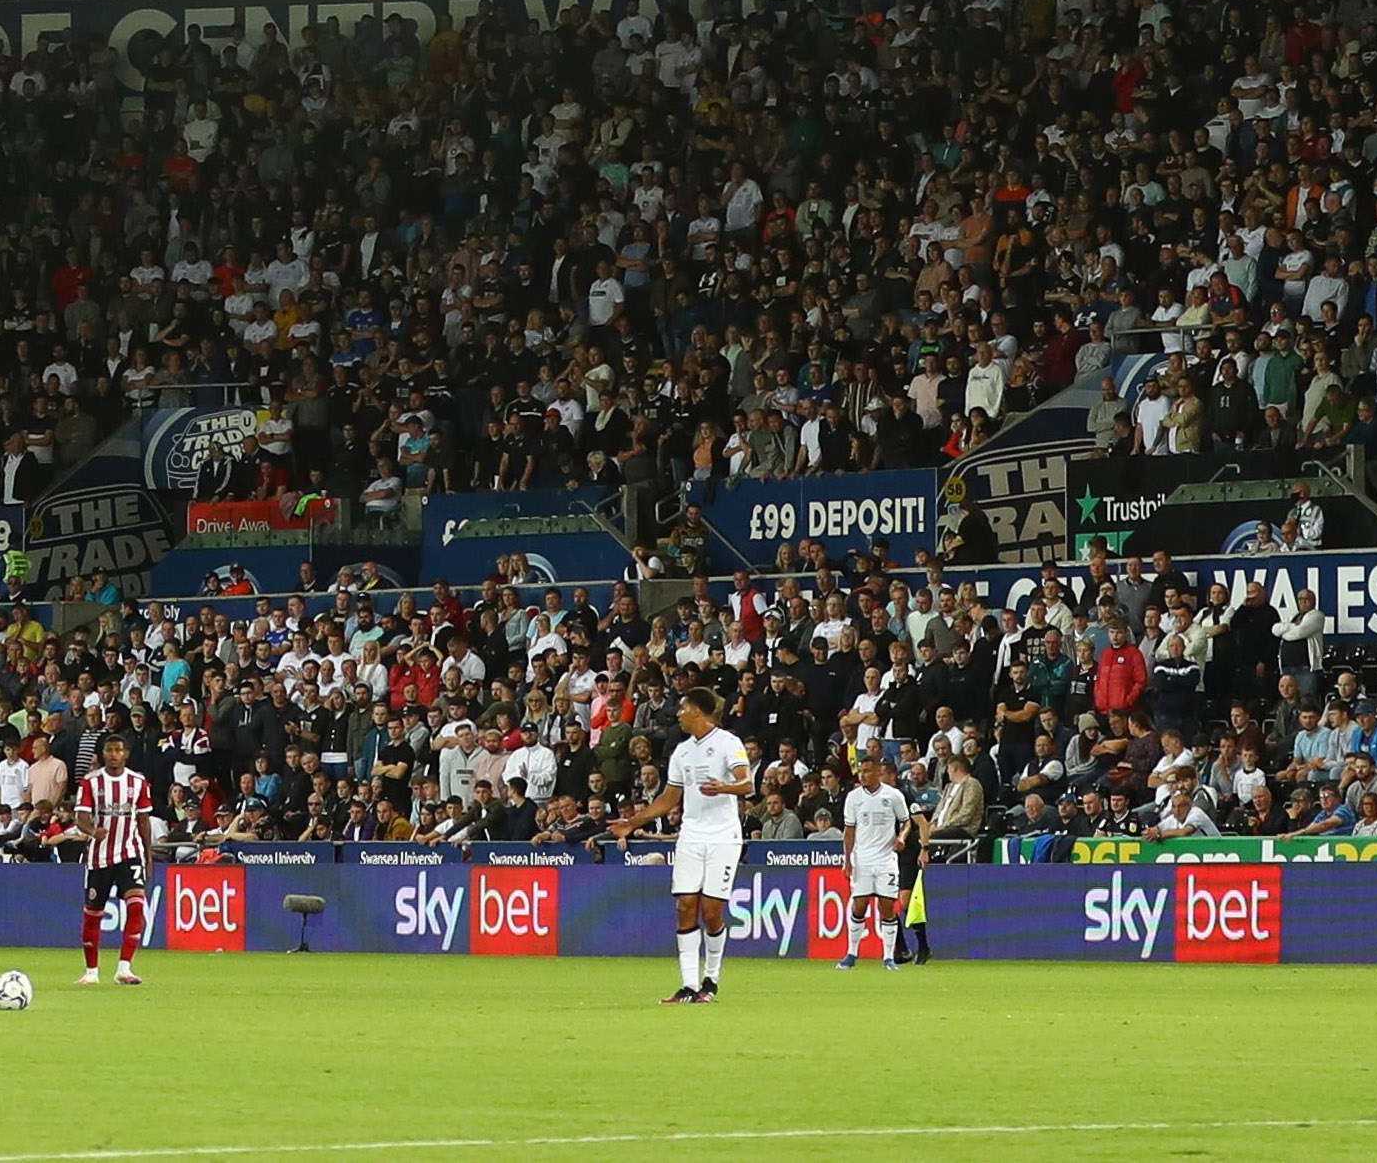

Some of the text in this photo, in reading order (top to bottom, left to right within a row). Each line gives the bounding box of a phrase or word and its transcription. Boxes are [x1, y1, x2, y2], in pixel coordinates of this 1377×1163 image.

[183, 429, 244, 452] TRAD
[197, 414, 240, 432] THE
[947, 482, 963, 496] 58
[977, 455, 1066, 497] TH
[51, 493, 140, 535] THE
[749, 497, 926, 540] £99 DEPOSIT!
[1102, 493, 1166, 522] Trustpil
[24, 529, 170, 585] TRADE
[130, 865, 142, 880] 7
[238, 851, 273, 864] Swansea
[275, 851, 316, 865] University
[360, 851, 398, 865] Swansea
[400, 851, 444, 865] University
[489, 851, 529, 865] Swansea
[530, 852, 575, 865] University
[766, 850, 808, 866] Swansea
[811, 850, 846, 866] Univers
[100, 873, 237, 948] sy bet
[395, 871, 549, 951] sky bet
[728, 872, 802, 957] sky
[1084, 870, 1269, 959] sky bet
